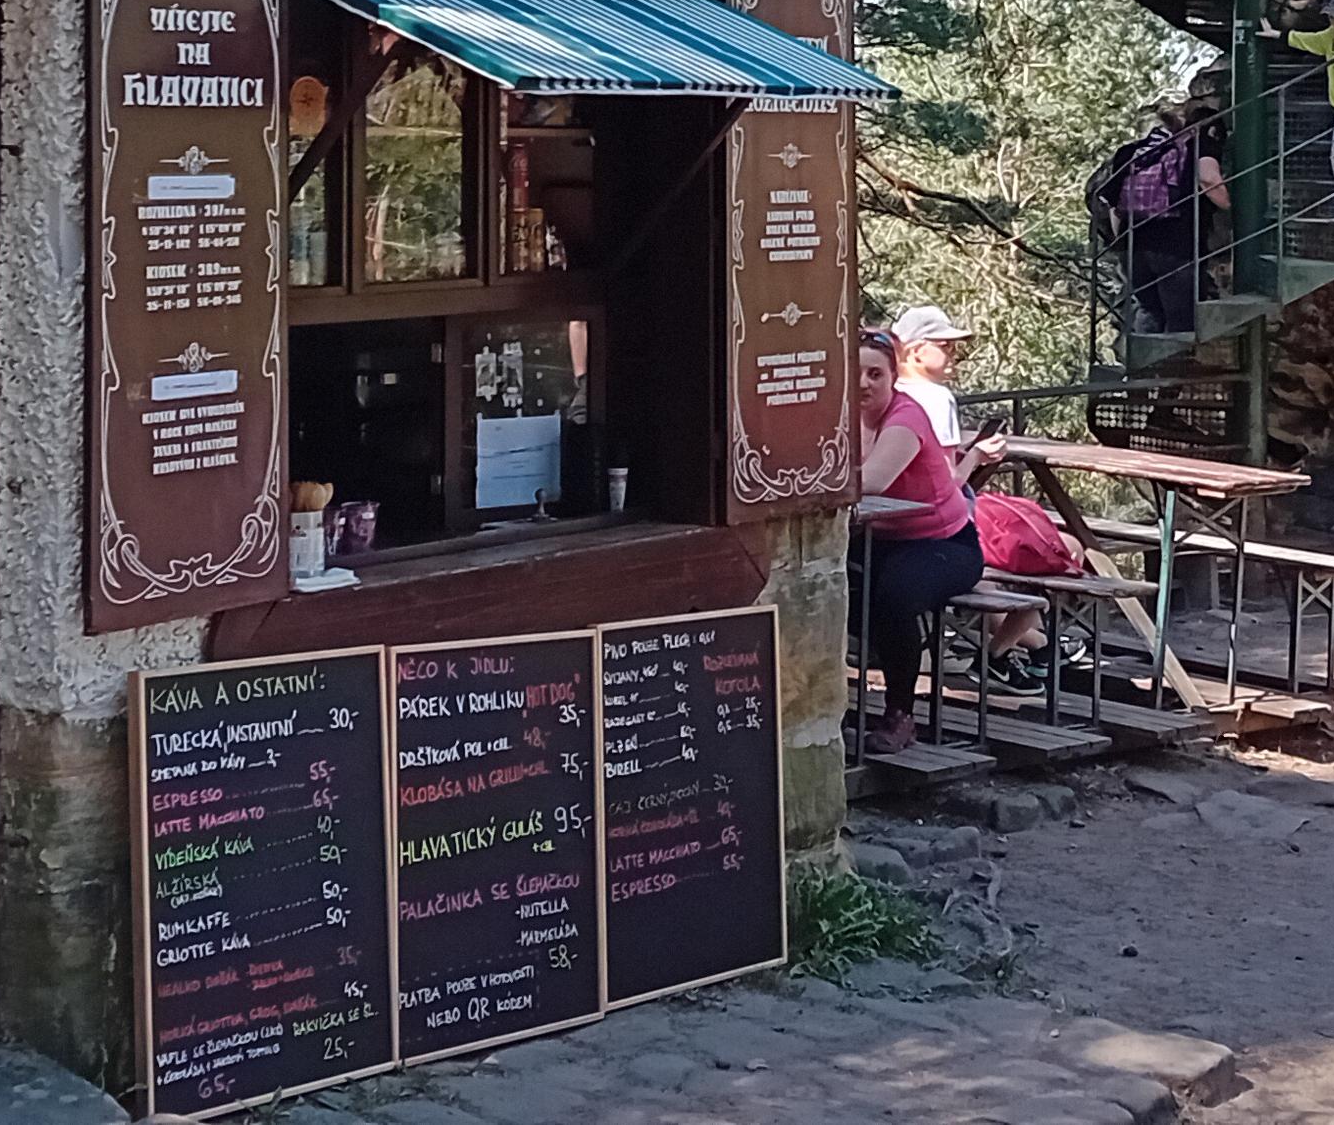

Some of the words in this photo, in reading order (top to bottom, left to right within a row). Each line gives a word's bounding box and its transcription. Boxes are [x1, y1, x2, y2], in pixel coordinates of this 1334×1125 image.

[177, 42, 211, 65] NA
[398, 658, 439, 684] NĚCO
[446, 659, 459, 679] K
[149, 682, 203, 715] KÁVA
[215, 682, 230, 705] A
[399, 693, 451, 720] PÁREK
[456, 694, 466, 713] V
[153, 787, 223, 812] ESPRESSO
[400, 777, 465, 807] KLOBÁSA
[468, 775, 487, 793] NA
[154, 817, 192, 838] LATTE
[610, 851, 645, 873] LATTE
[399, 887, 483, 921] PALAČINKA
[491, 882, 511, 902] SE
[611, 873, 676, 903] ESPRESSO
[427, 1008, 461, 1029] NEBO
[467, 997, 490, 1023] QR
